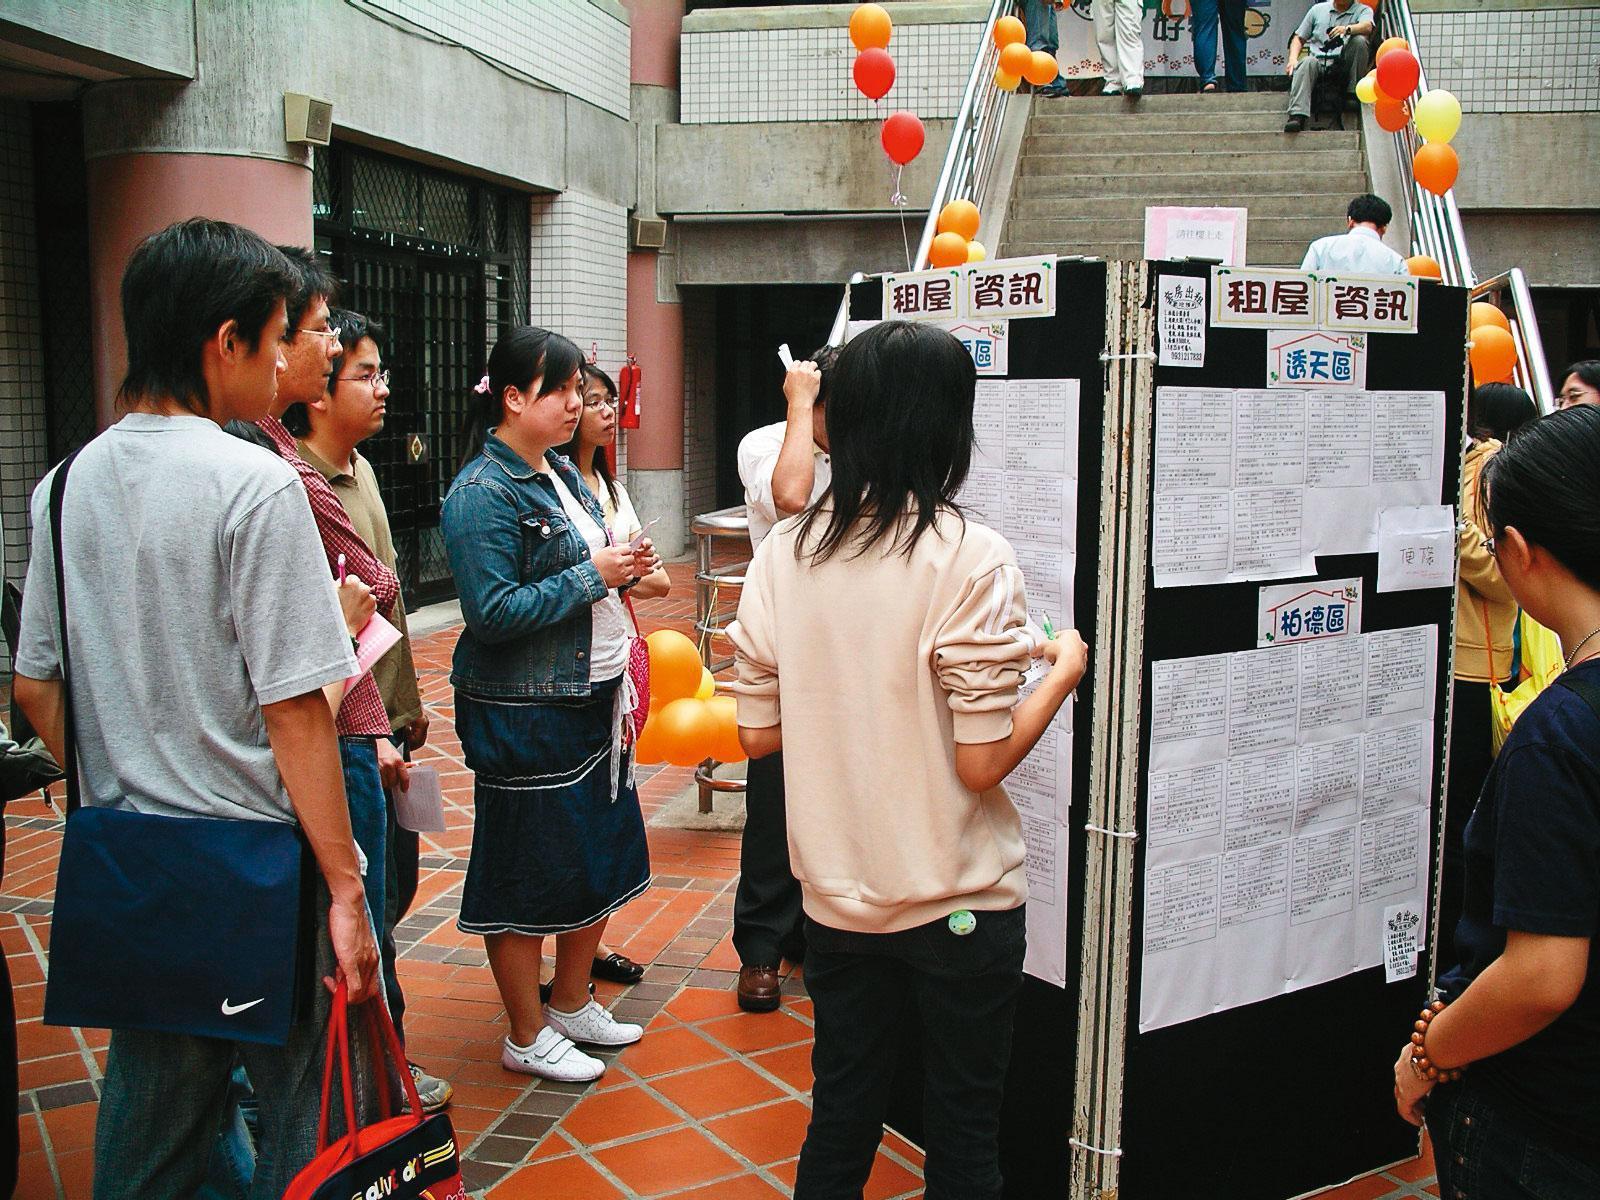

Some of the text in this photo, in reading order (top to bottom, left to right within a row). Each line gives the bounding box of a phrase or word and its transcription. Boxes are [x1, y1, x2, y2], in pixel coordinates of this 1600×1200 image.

[1286, 349, 1352, 381] 透天區
[1280, 603, 1346, 637] 柏德區
